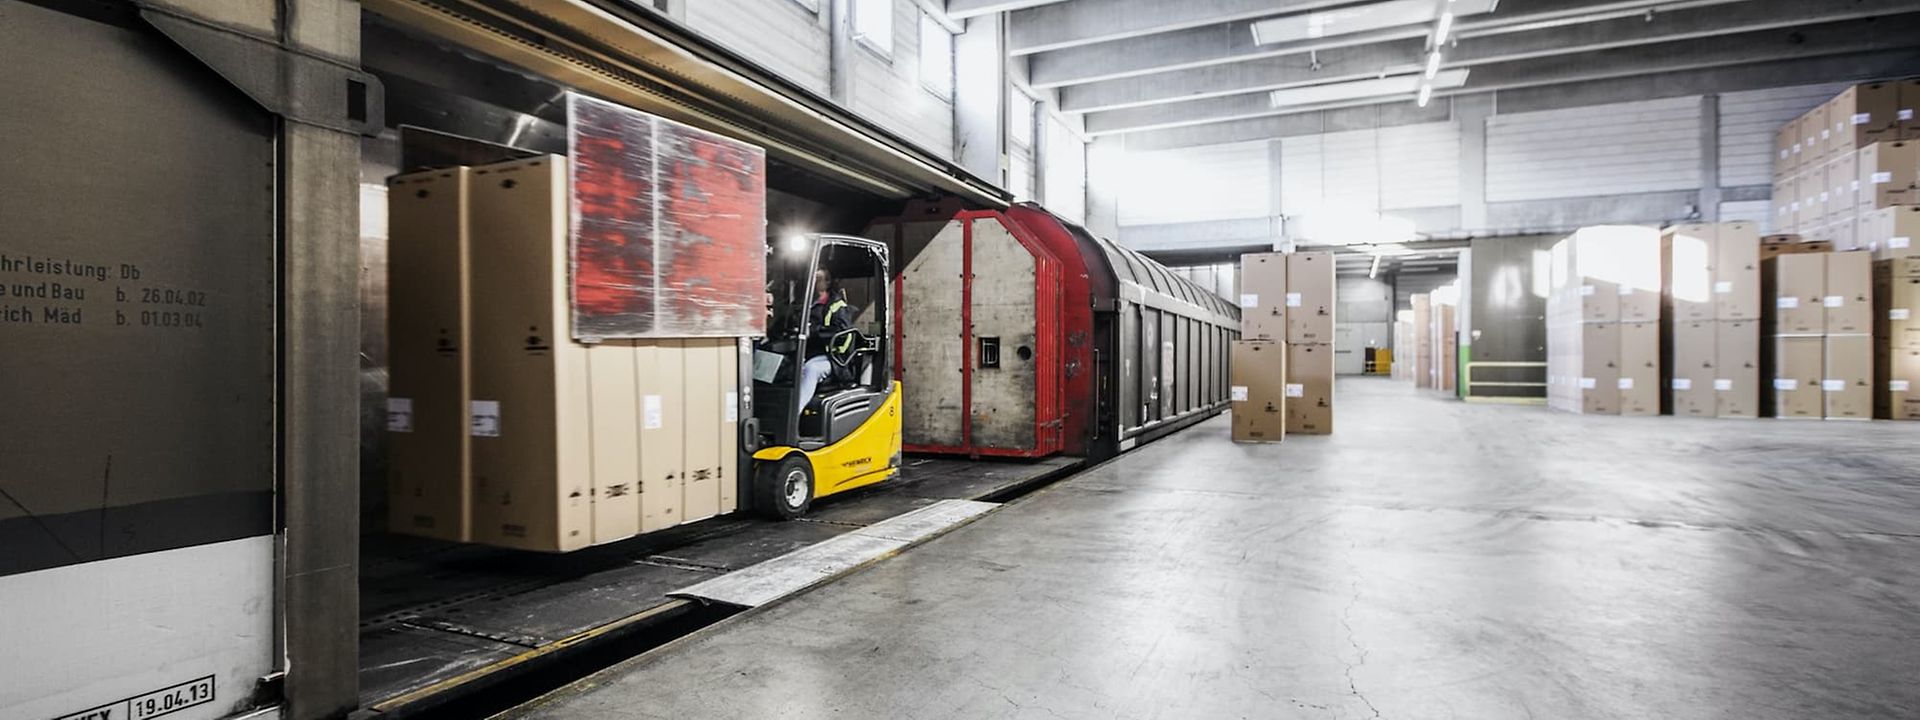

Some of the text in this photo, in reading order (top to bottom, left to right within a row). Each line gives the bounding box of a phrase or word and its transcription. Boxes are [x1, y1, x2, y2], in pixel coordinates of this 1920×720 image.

[120, 264, 141, 280] Db
[12, 283, 46, 298] und
[52, 284, 84, 301] Bau
[136, 683, 208, 717] 19.04.13
